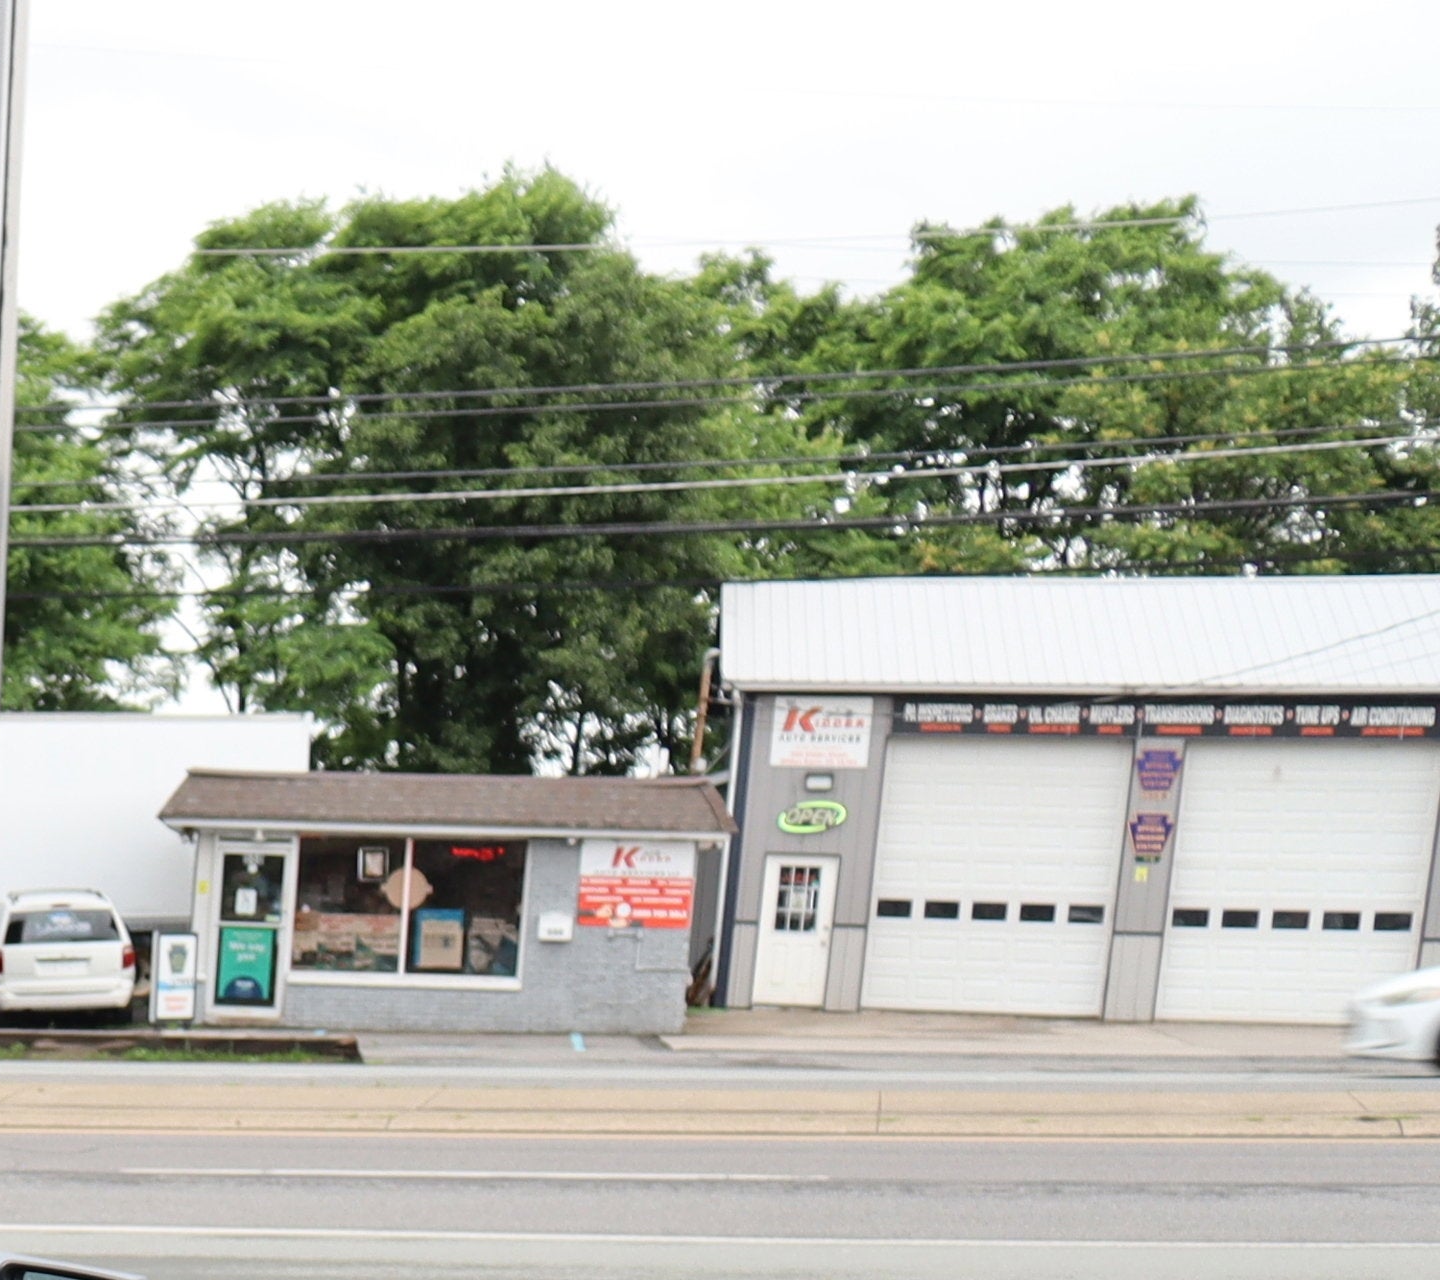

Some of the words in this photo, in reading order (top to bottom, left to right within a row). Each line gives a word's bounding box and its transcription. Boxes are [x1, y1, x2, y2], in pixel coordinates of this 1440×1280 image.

[1045, 705, 1081, 724] CHANGE
[1089, 705, 1135, 725] MUFFLERS
[1223, 705, 1285, 725] DIAGNOSTICS
[1369, 707, 1436, 726] CONDITIONING
[787, 808, 837, 826] OPEN
